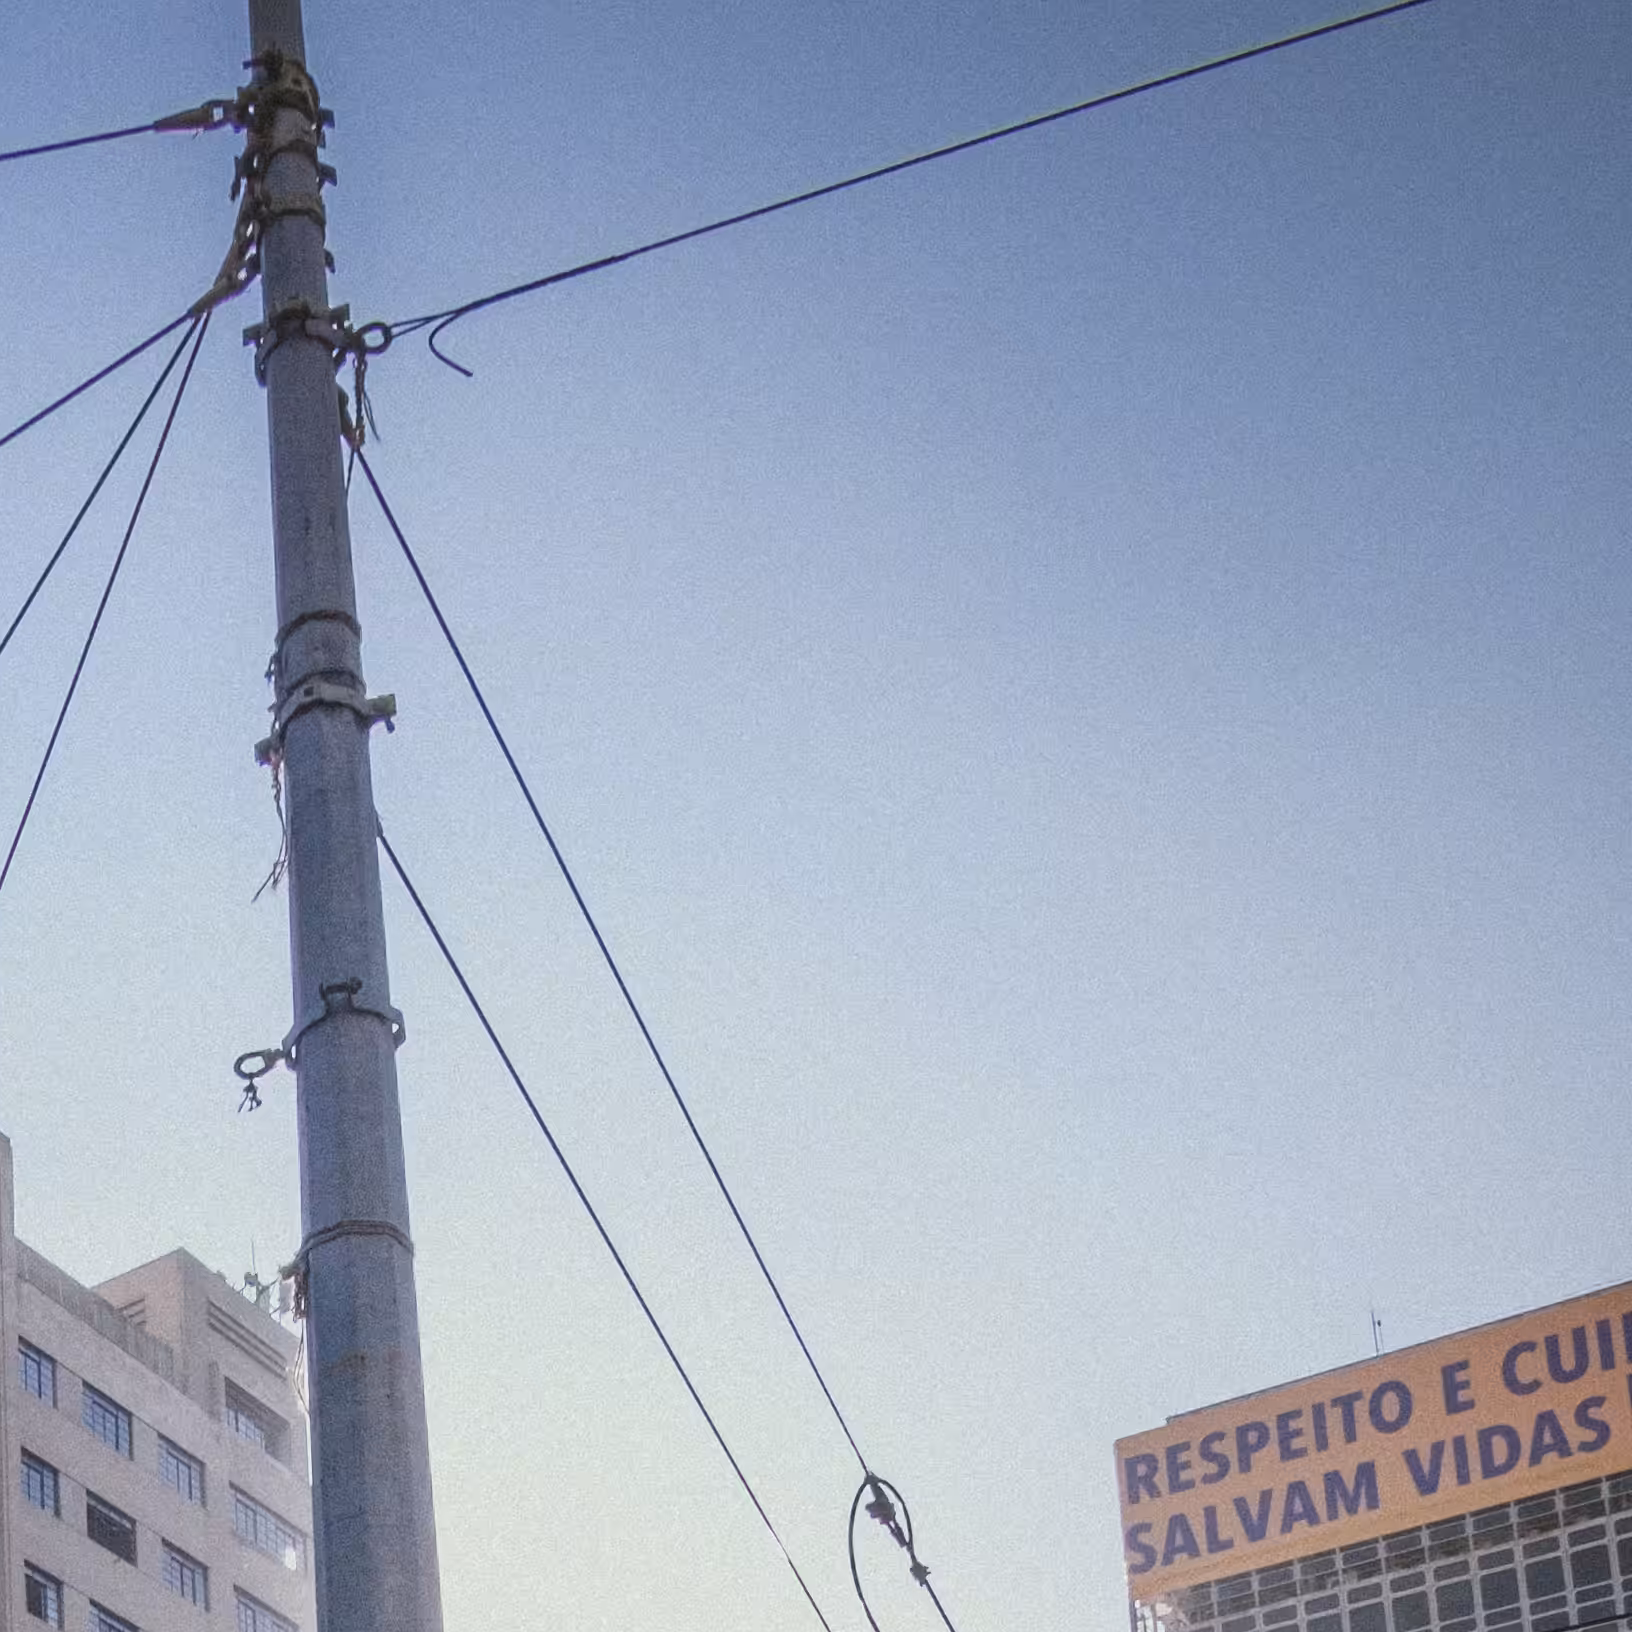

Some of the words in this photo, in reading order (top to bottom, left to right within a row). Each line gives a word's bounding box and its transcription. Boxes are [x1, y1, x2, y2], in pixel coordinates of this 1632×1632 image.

[1124, 1379, 1413, 1505] RESPEITO
[1441, 1360, 1475, 1417] E
[1501, 1311, 1632, 1396] CUI
[1126, 1460, 1380, 1575] SALVAM
[1402, 1396, 1611, 1497] VIDAS
